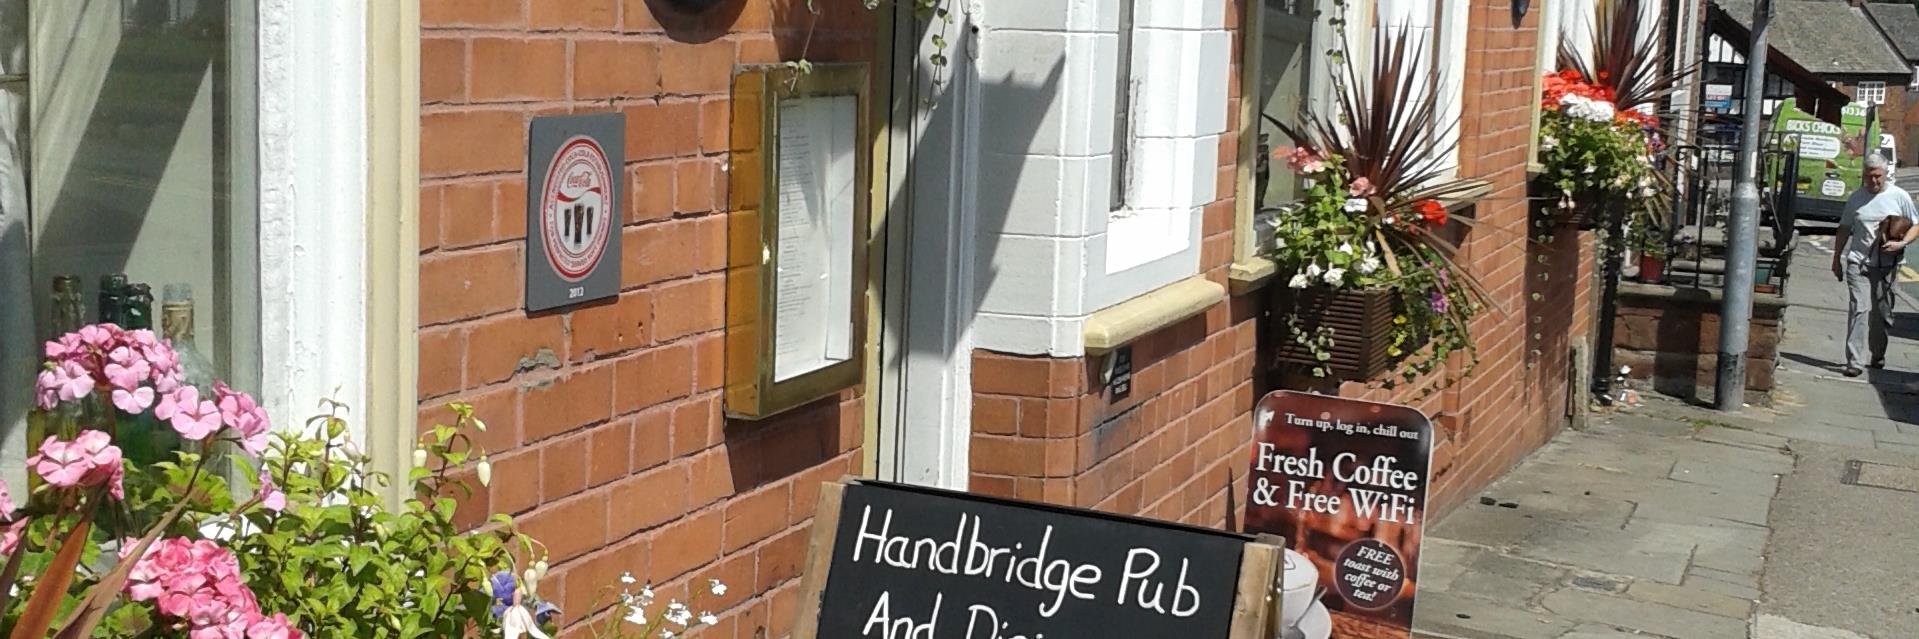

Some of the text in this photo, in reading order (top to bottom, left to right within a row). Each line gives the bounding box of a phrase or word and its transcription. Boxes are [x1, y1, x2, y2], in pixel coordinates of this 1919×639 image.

[1284, 412, 1419, 440] Turn up, log in, chill out
[1255, 441, 1418, 491] Fresh Coffee
[1252, 476, 1416, 525] & Free WiFi
[852, 504, 1201, 618] Handbridge Pub
[1343, 558, 1400, 581] toast with
[1356, 545, 1395, 566] FREE
[1344, 573, 1393, 592] coffee or
[1352, 589, 1378, 602] tea!
[862, 590, 943, 639] And
